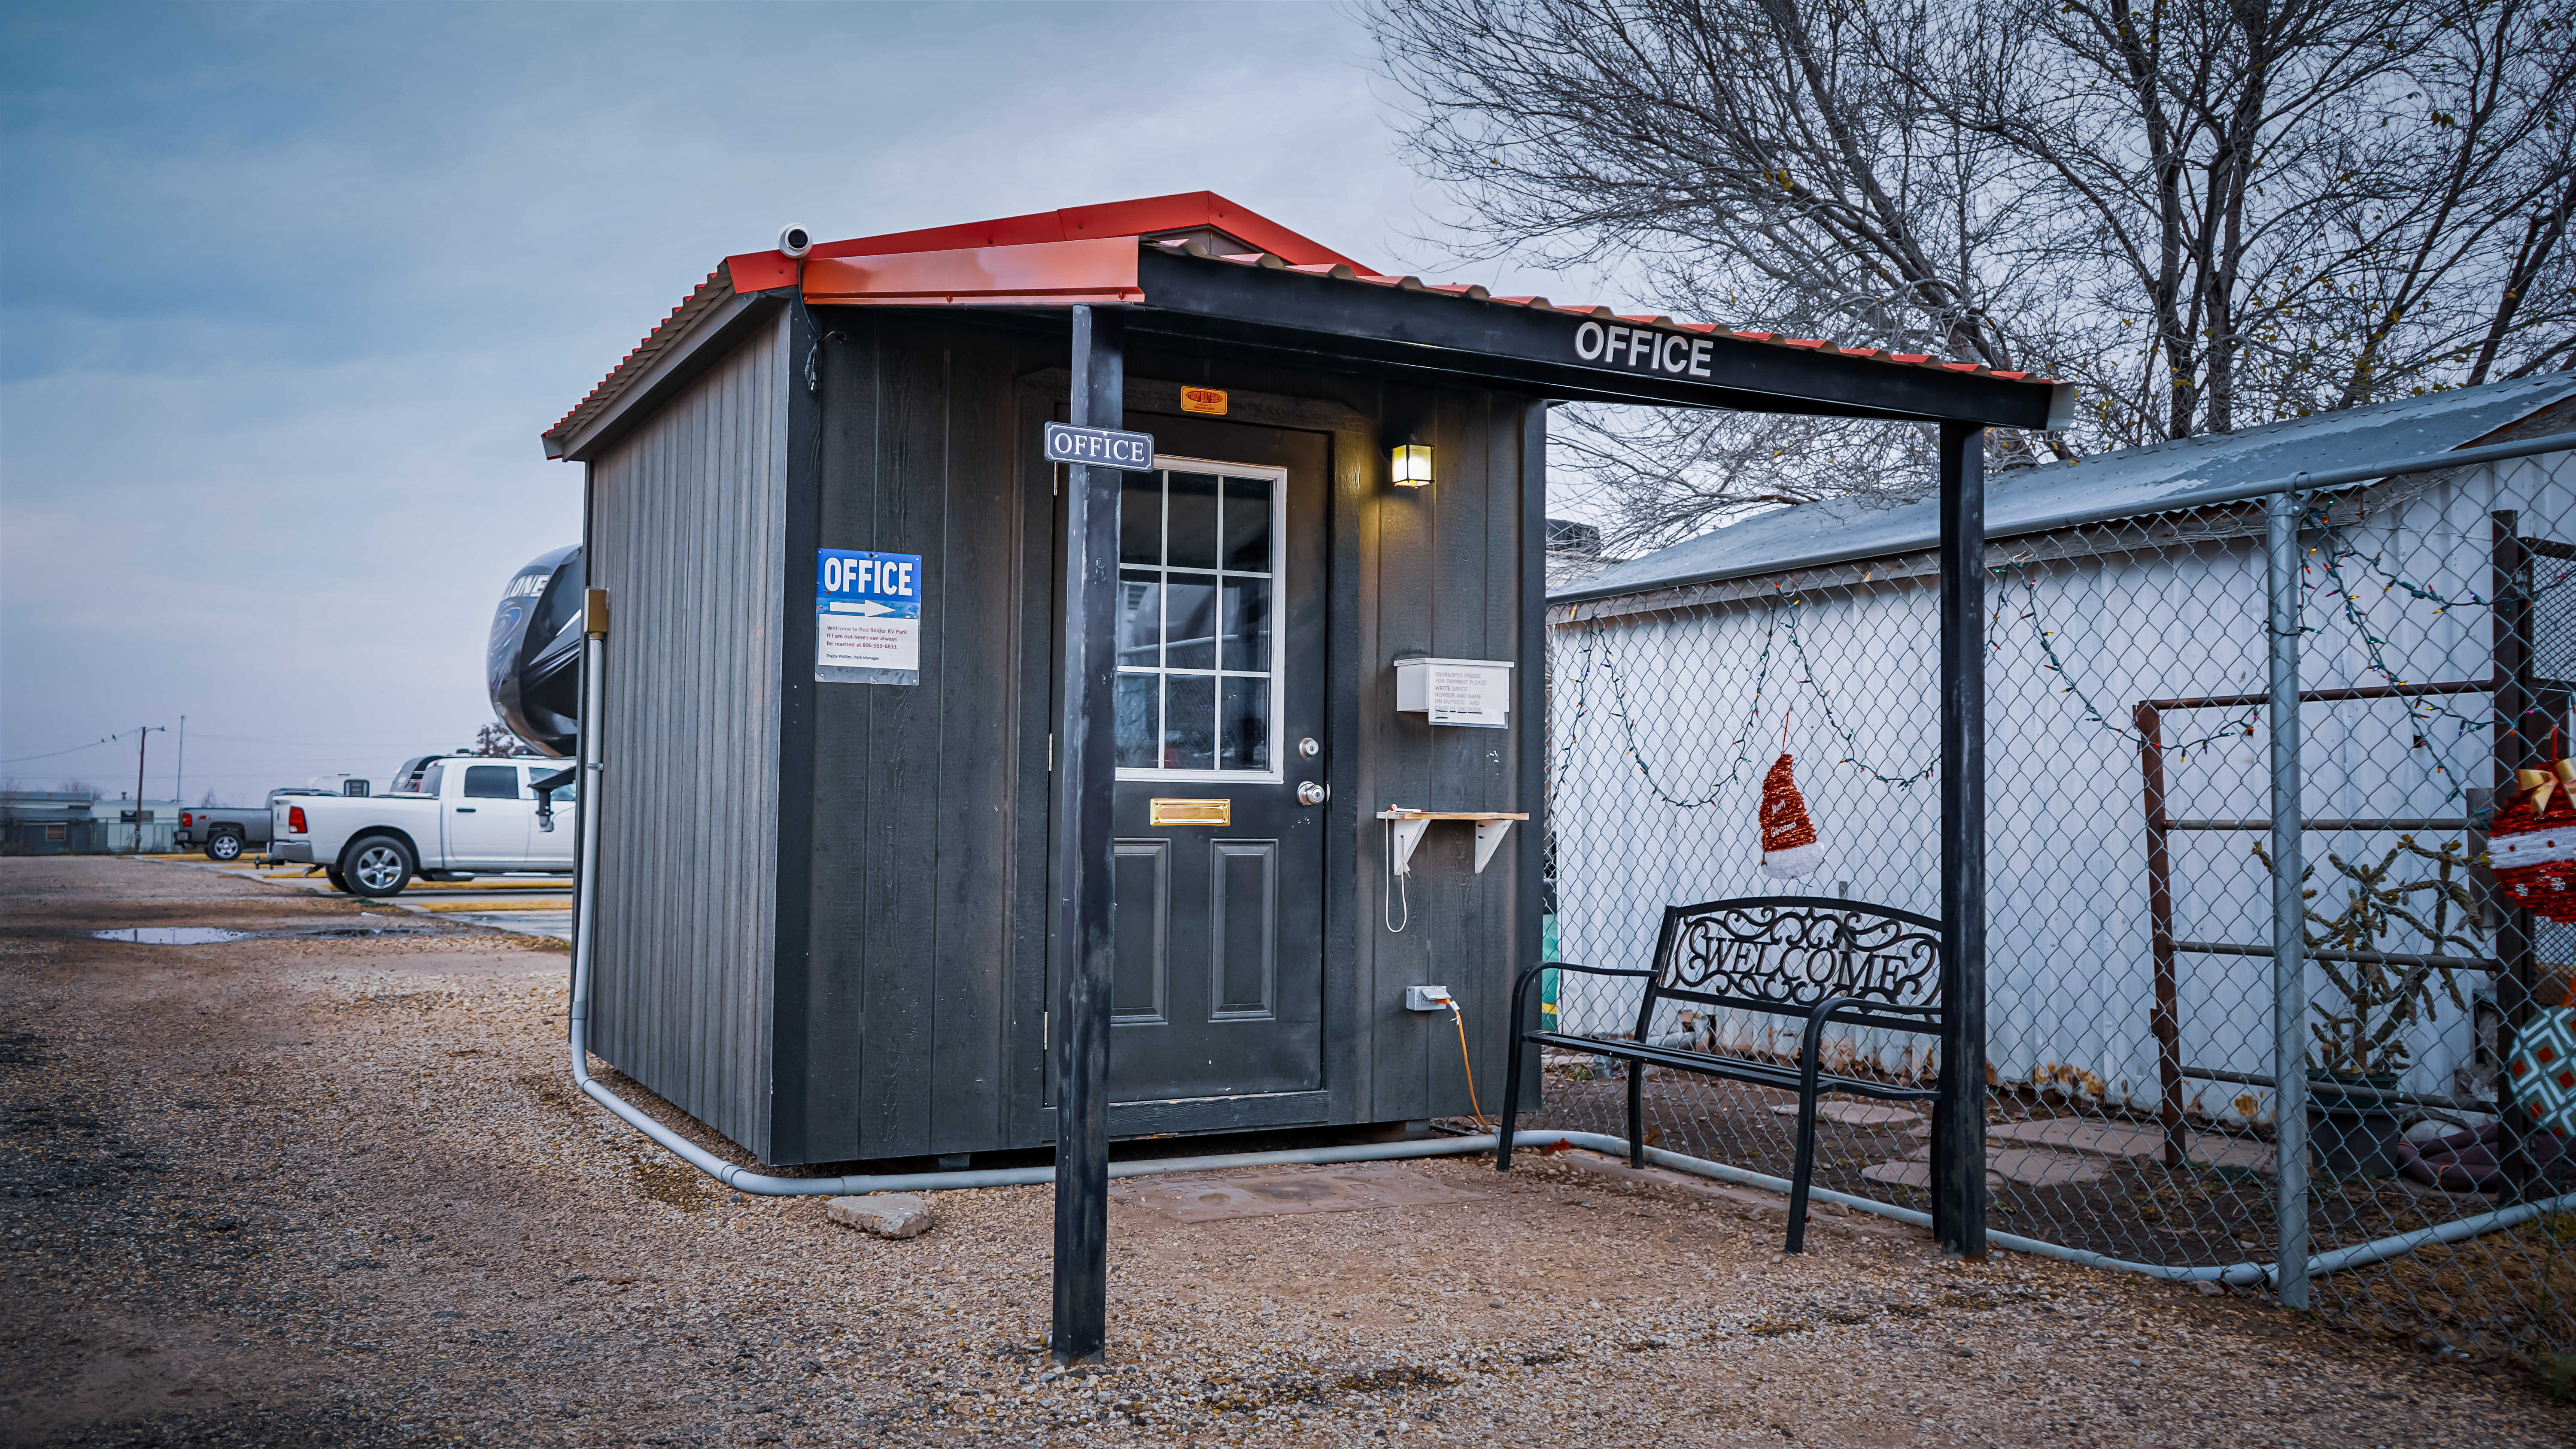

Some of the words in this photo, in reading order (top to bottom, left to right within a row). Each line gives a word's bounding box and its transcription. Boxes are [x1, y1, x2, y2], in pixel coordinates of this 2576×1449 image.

[1575, 321, 1713, 377] OFFICE
[1186, 391, 1200, 402] STURDY
[1211, 393, 1223, 402] SHEDS
[1055, 433, 1145, 462] OFFICE
[824, 558, 913, 596] OFFICE
[1689, 932, 1909, 994] WELCOME
